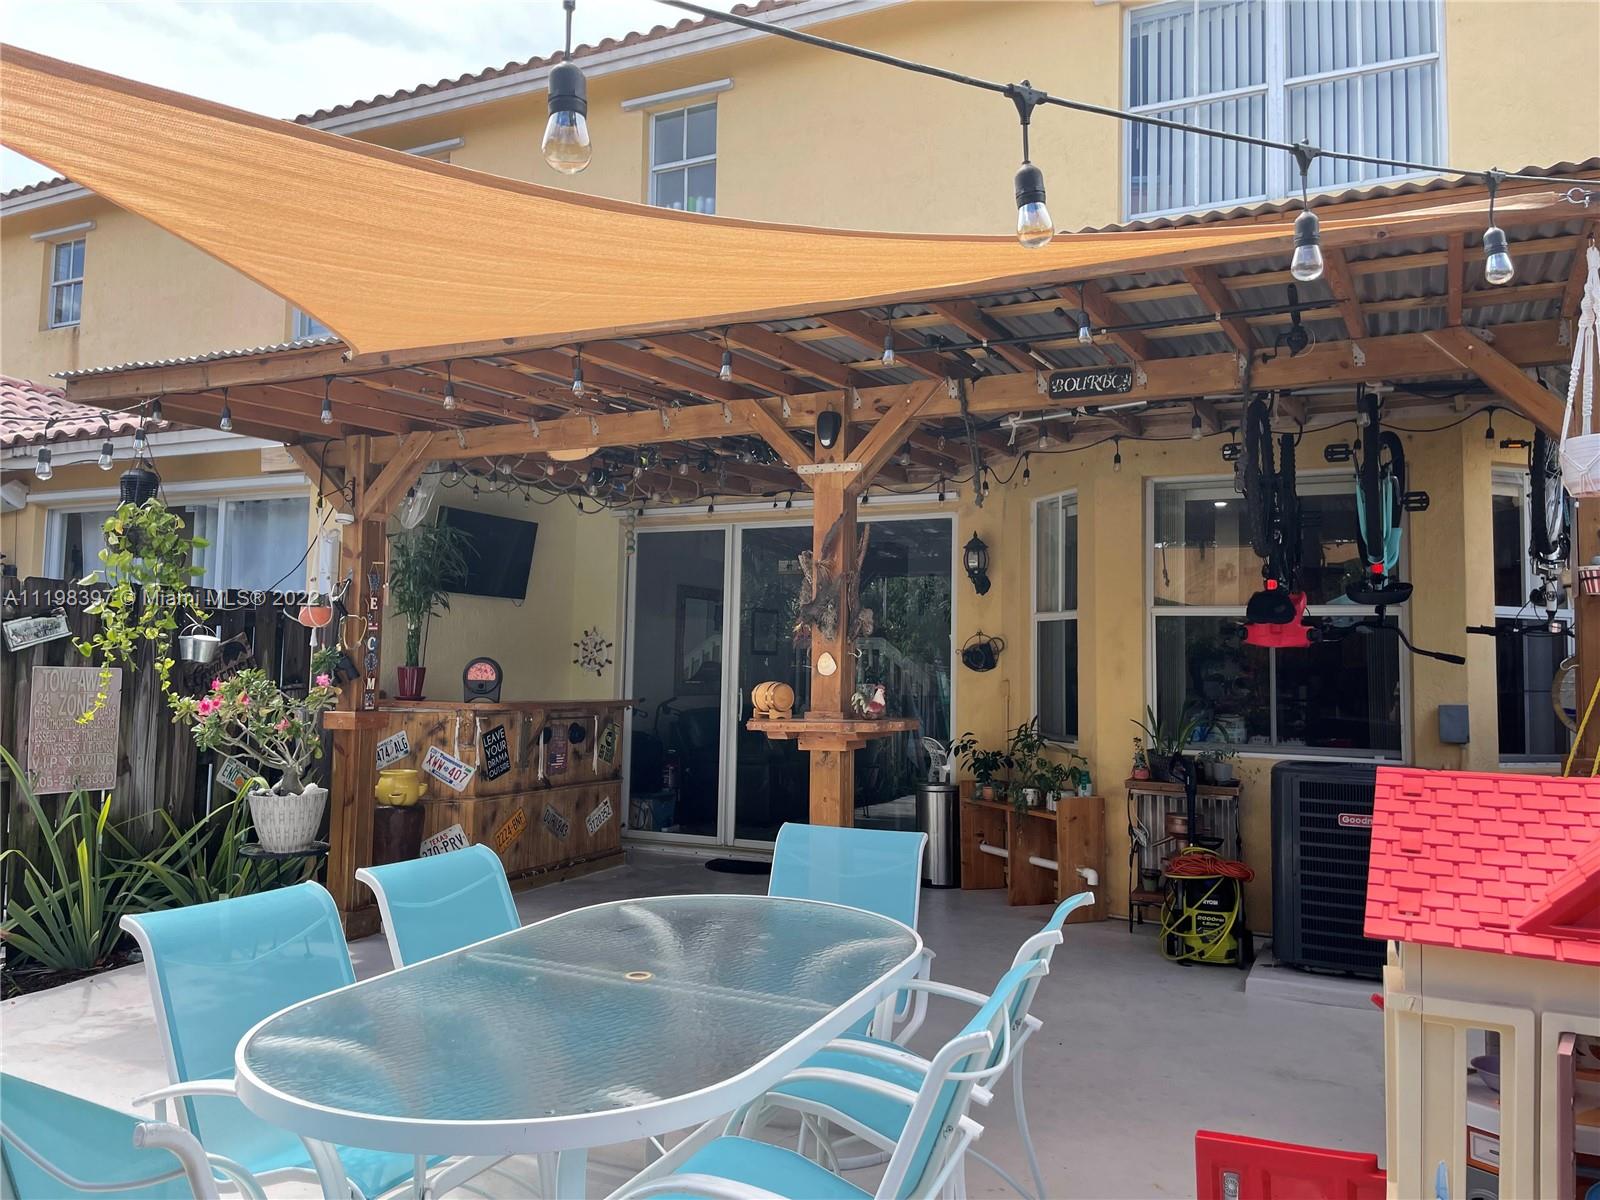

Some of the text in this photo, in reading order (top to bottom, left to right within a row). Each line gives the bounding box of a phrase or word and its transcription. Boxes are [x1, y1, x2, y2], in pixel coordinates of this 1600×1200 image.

[43, 669, 106, 692] TOW-AW
[483, 728, 505, 747] LEAVE
[485, 740, 507, 758] YOUR
[487, 751, 509, 769] DRAMA
[489, 760, 511, 778] OUTSIDE
[448, 767, 469, 784] 407
[429, 832, 449, 847] TEXAS
